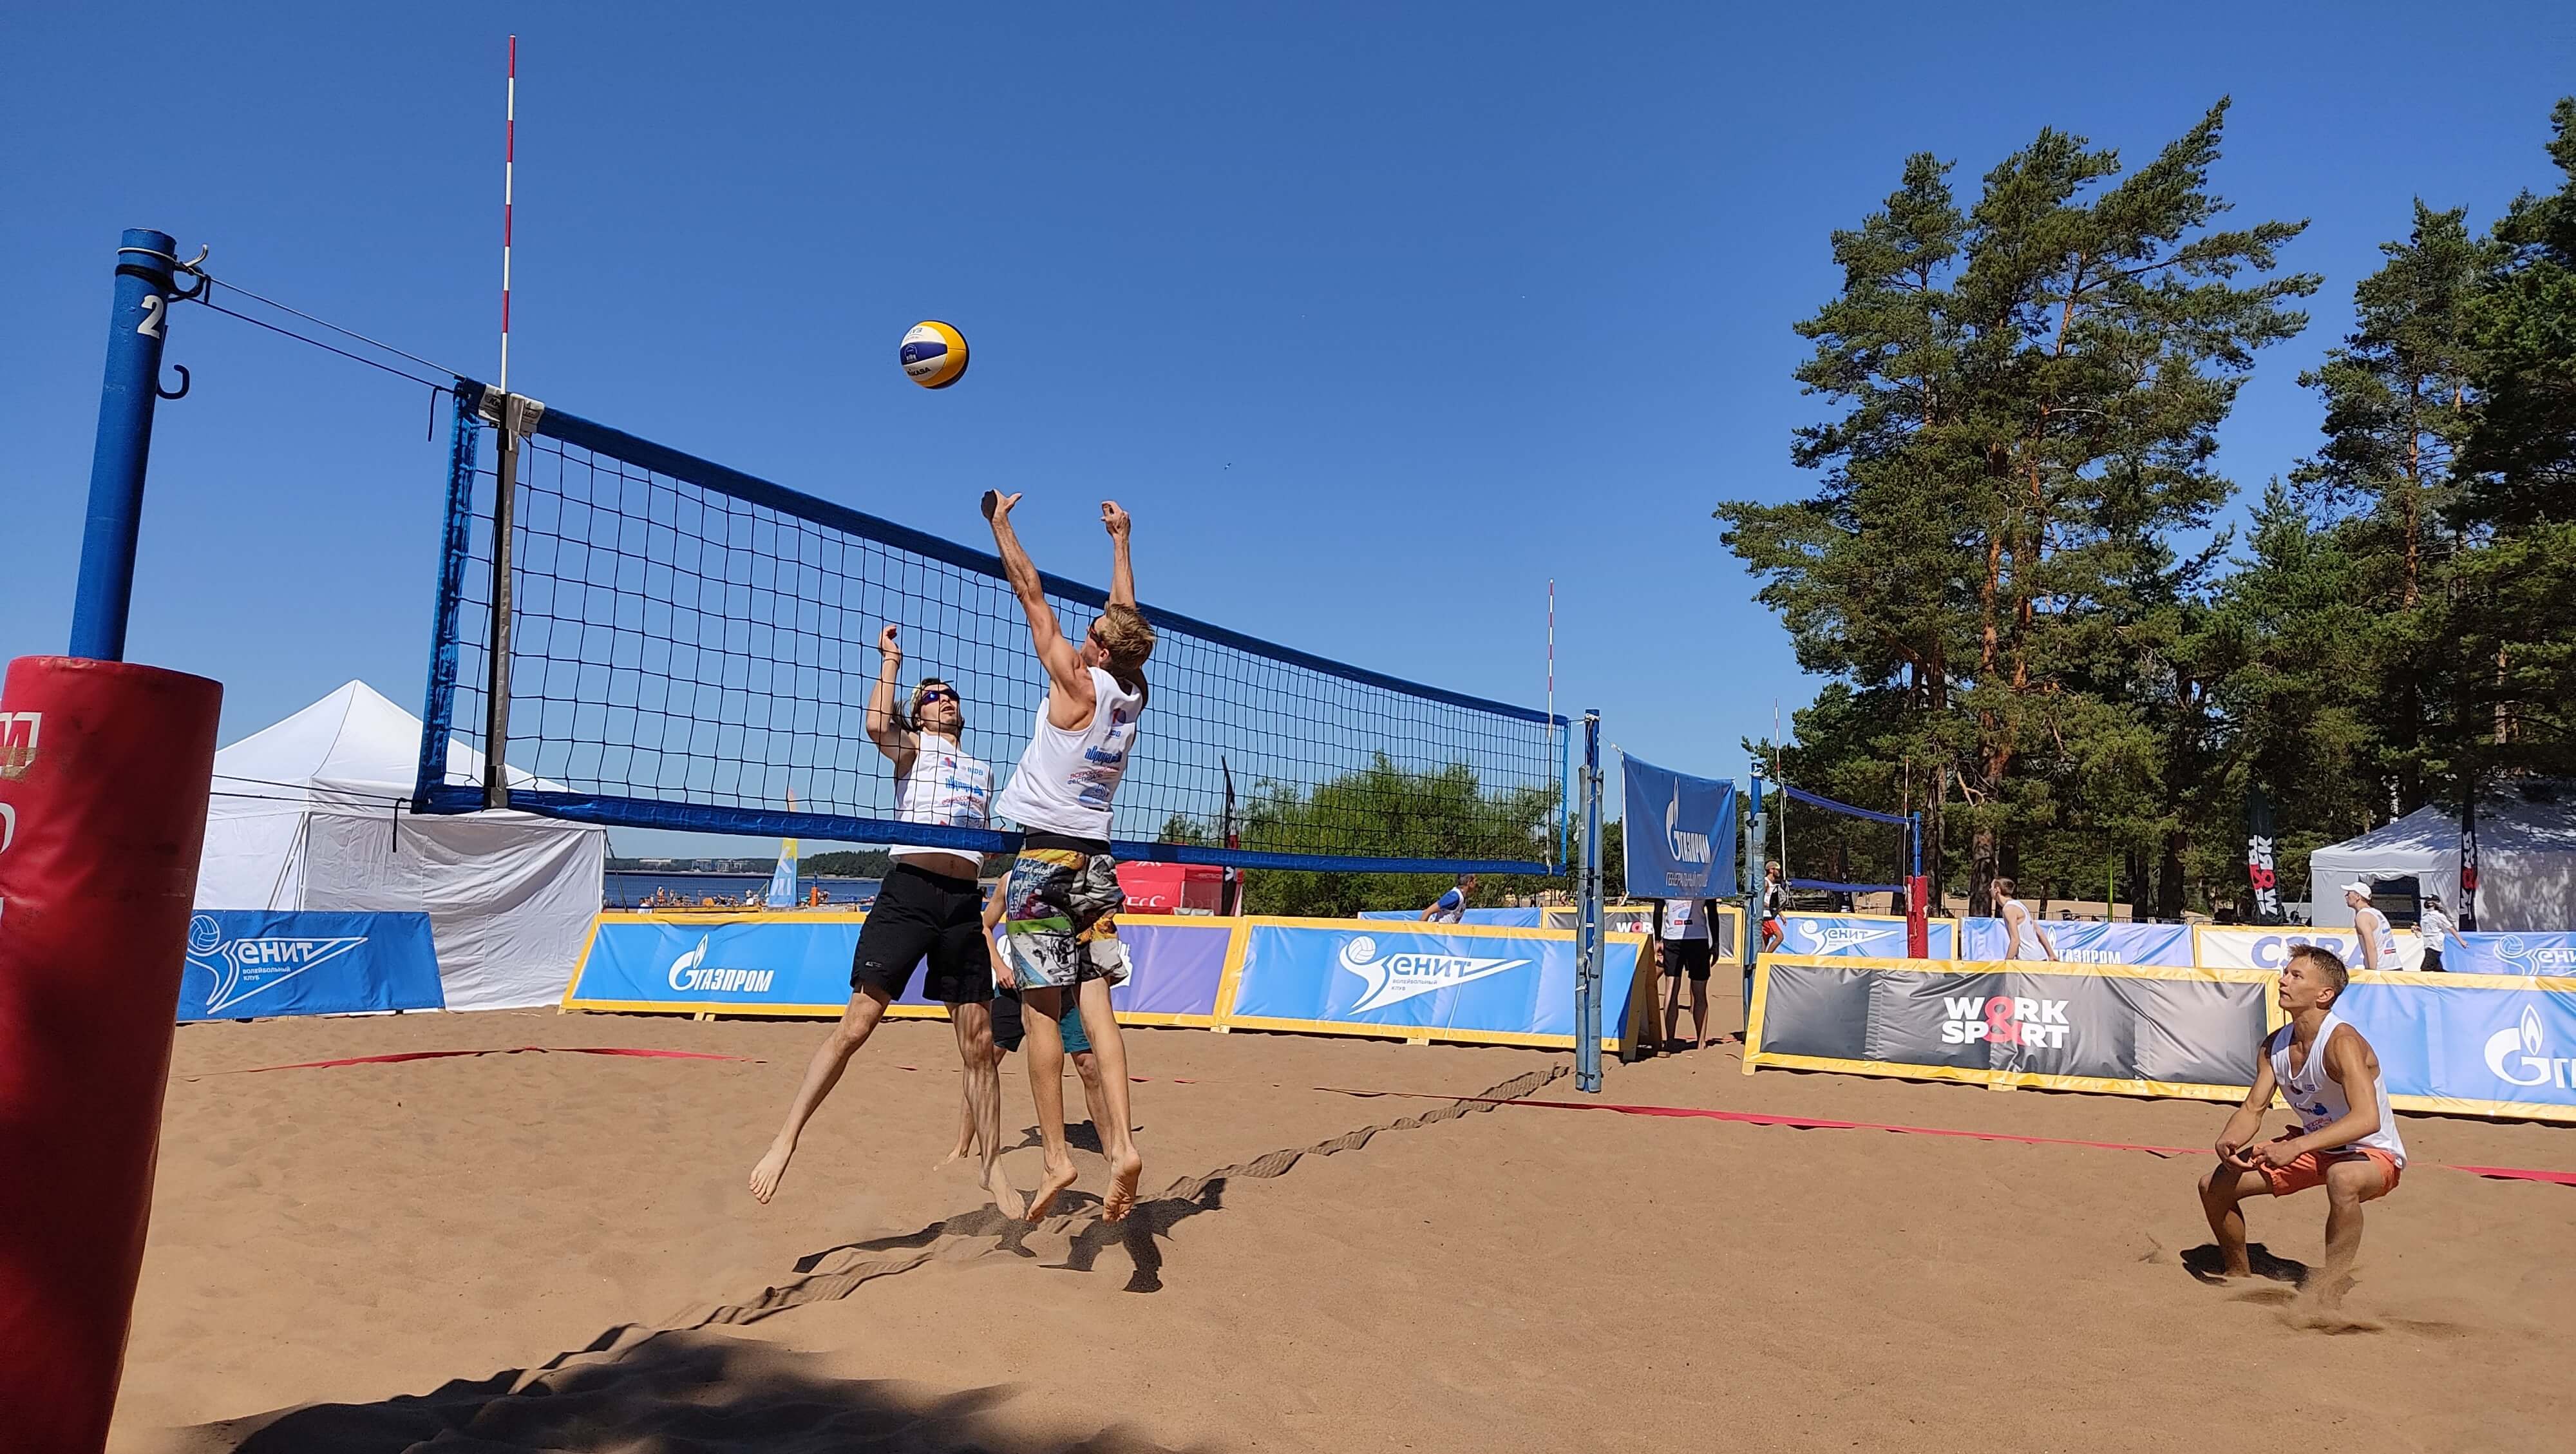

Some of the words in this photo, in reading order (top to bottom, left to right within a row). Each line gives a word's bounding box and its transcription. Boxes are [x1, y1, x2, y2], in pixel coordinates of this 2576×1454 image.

[137, 294, 164, 339] 2
[242, 966, 291, 975] ВОЛЕЙБОЛЬНЫЙ
[694, 968, 774, 992] ГАЗПРОМ
